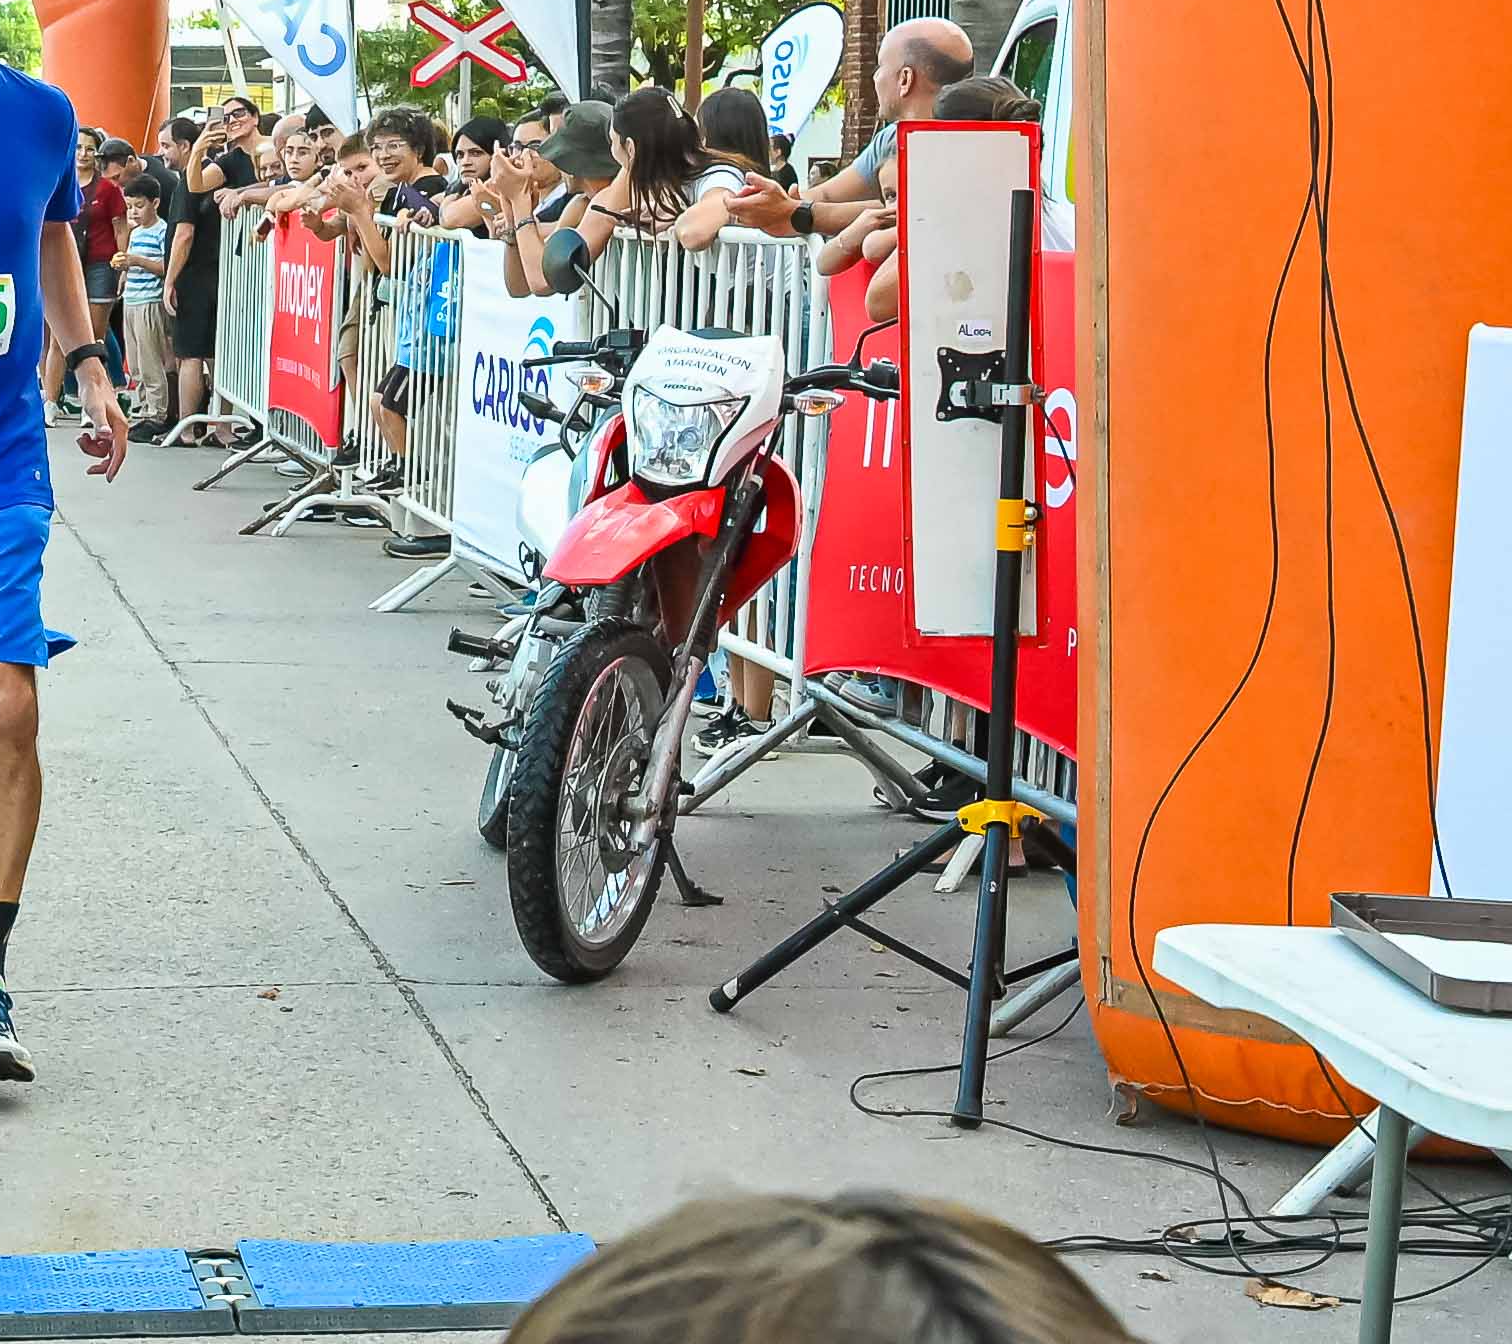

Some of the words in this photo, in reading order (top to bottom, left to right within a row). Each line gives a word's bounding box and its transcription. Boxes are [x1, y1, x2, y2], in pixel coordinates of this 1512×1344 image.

[278, 242, 324, 337] moplex
[473, 351, 549, 436] CARUSO
[663, 383, 703, 392] HONDA
[849, 564, 905, 594] TECNO
